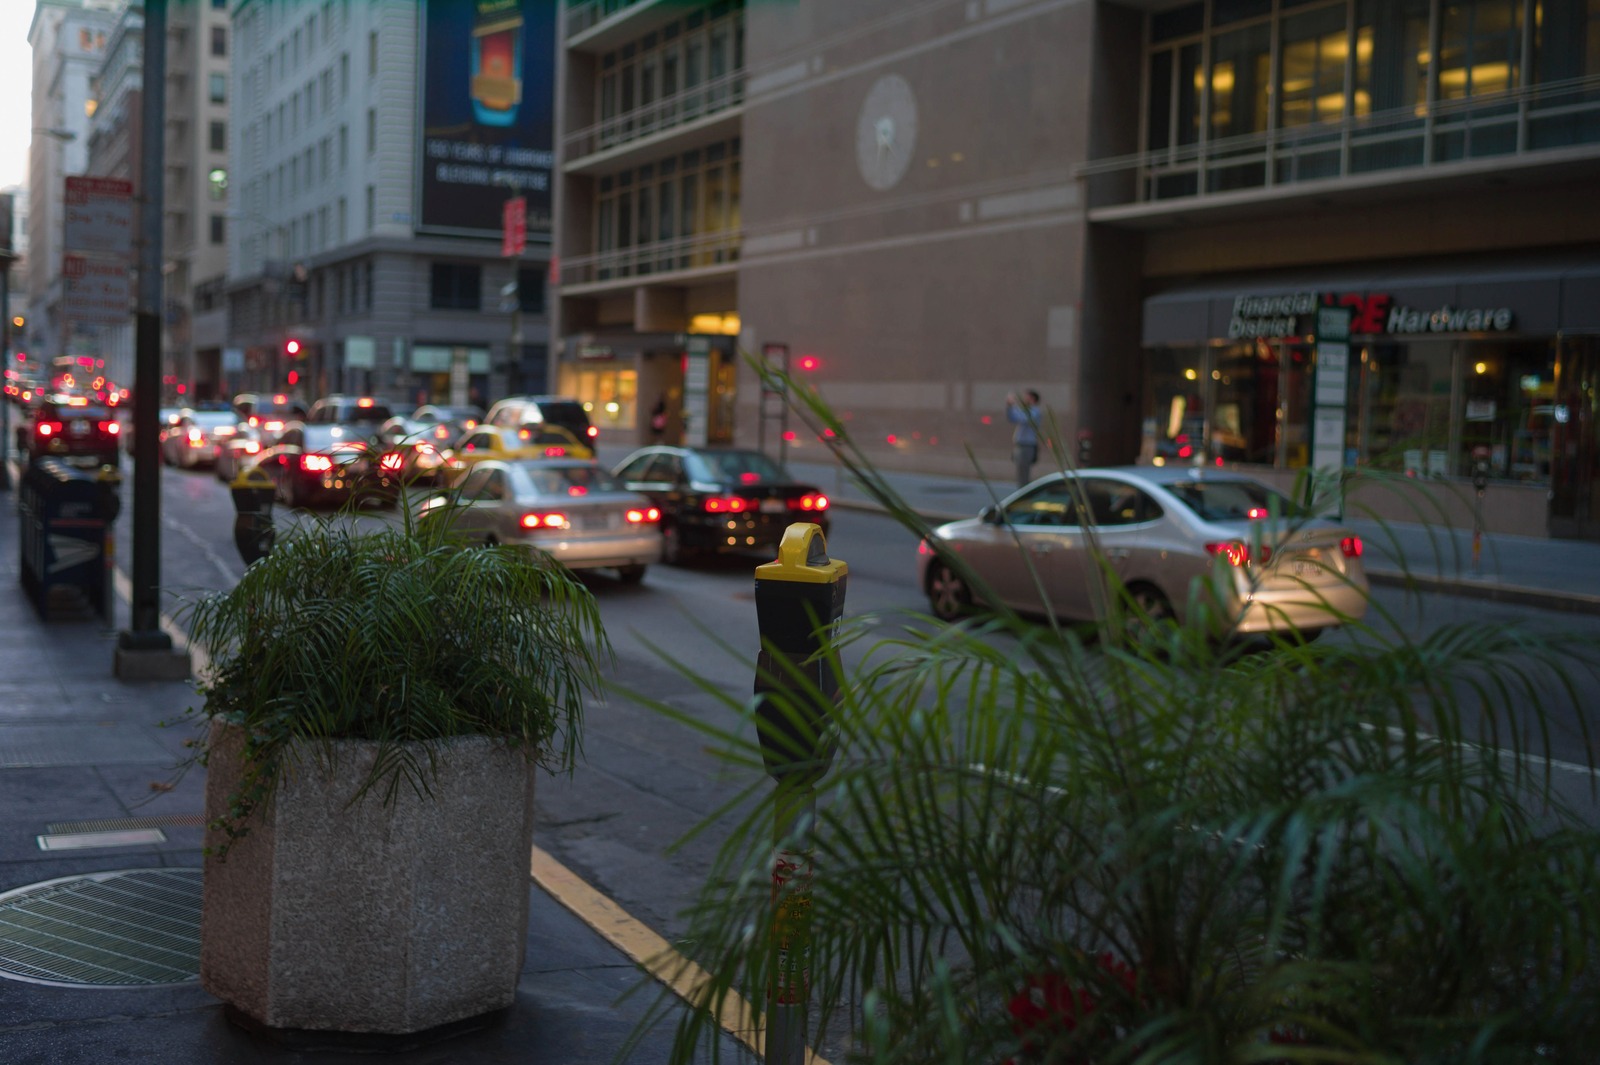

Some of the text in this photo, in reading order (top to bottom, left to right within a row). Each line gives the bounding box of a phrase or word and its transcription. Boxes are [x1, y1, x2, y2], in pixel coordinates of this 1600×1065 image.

[505, 149, 552, 167] UNBROKE
[492, 169, 547, 189] EERTISE
[1233, 291, 1318, 316] Financial
[1228, 315, 1297, 339] District
[1387, 305, 1512, 333] Hardware
